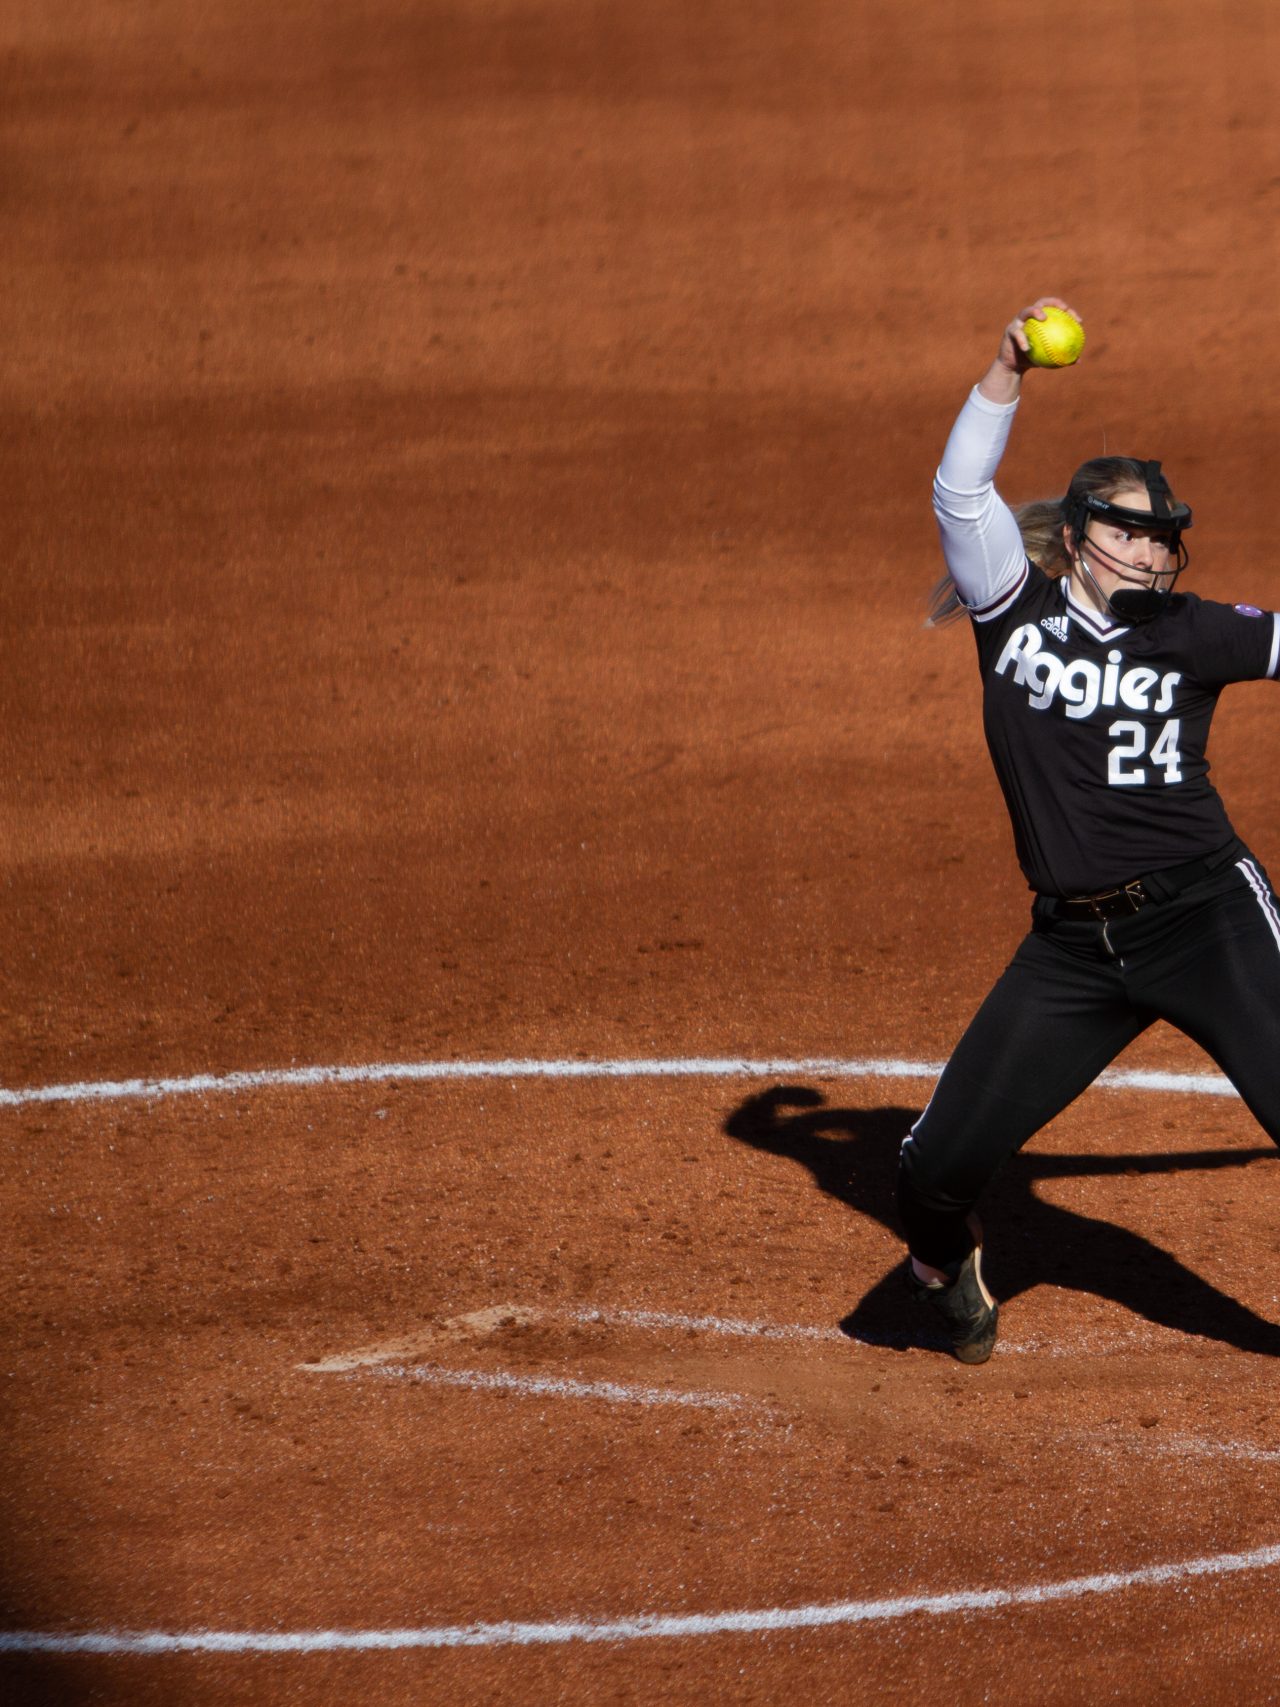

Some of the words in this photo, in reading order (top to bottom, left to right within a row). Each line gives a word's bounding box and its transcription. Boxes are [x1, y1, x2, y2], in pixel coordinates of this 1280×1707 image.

[1040, 617, 1068, 643] adidas
[994, 623, 1182, 719] Aggies
[1107, 718, 1182, 785] 24
